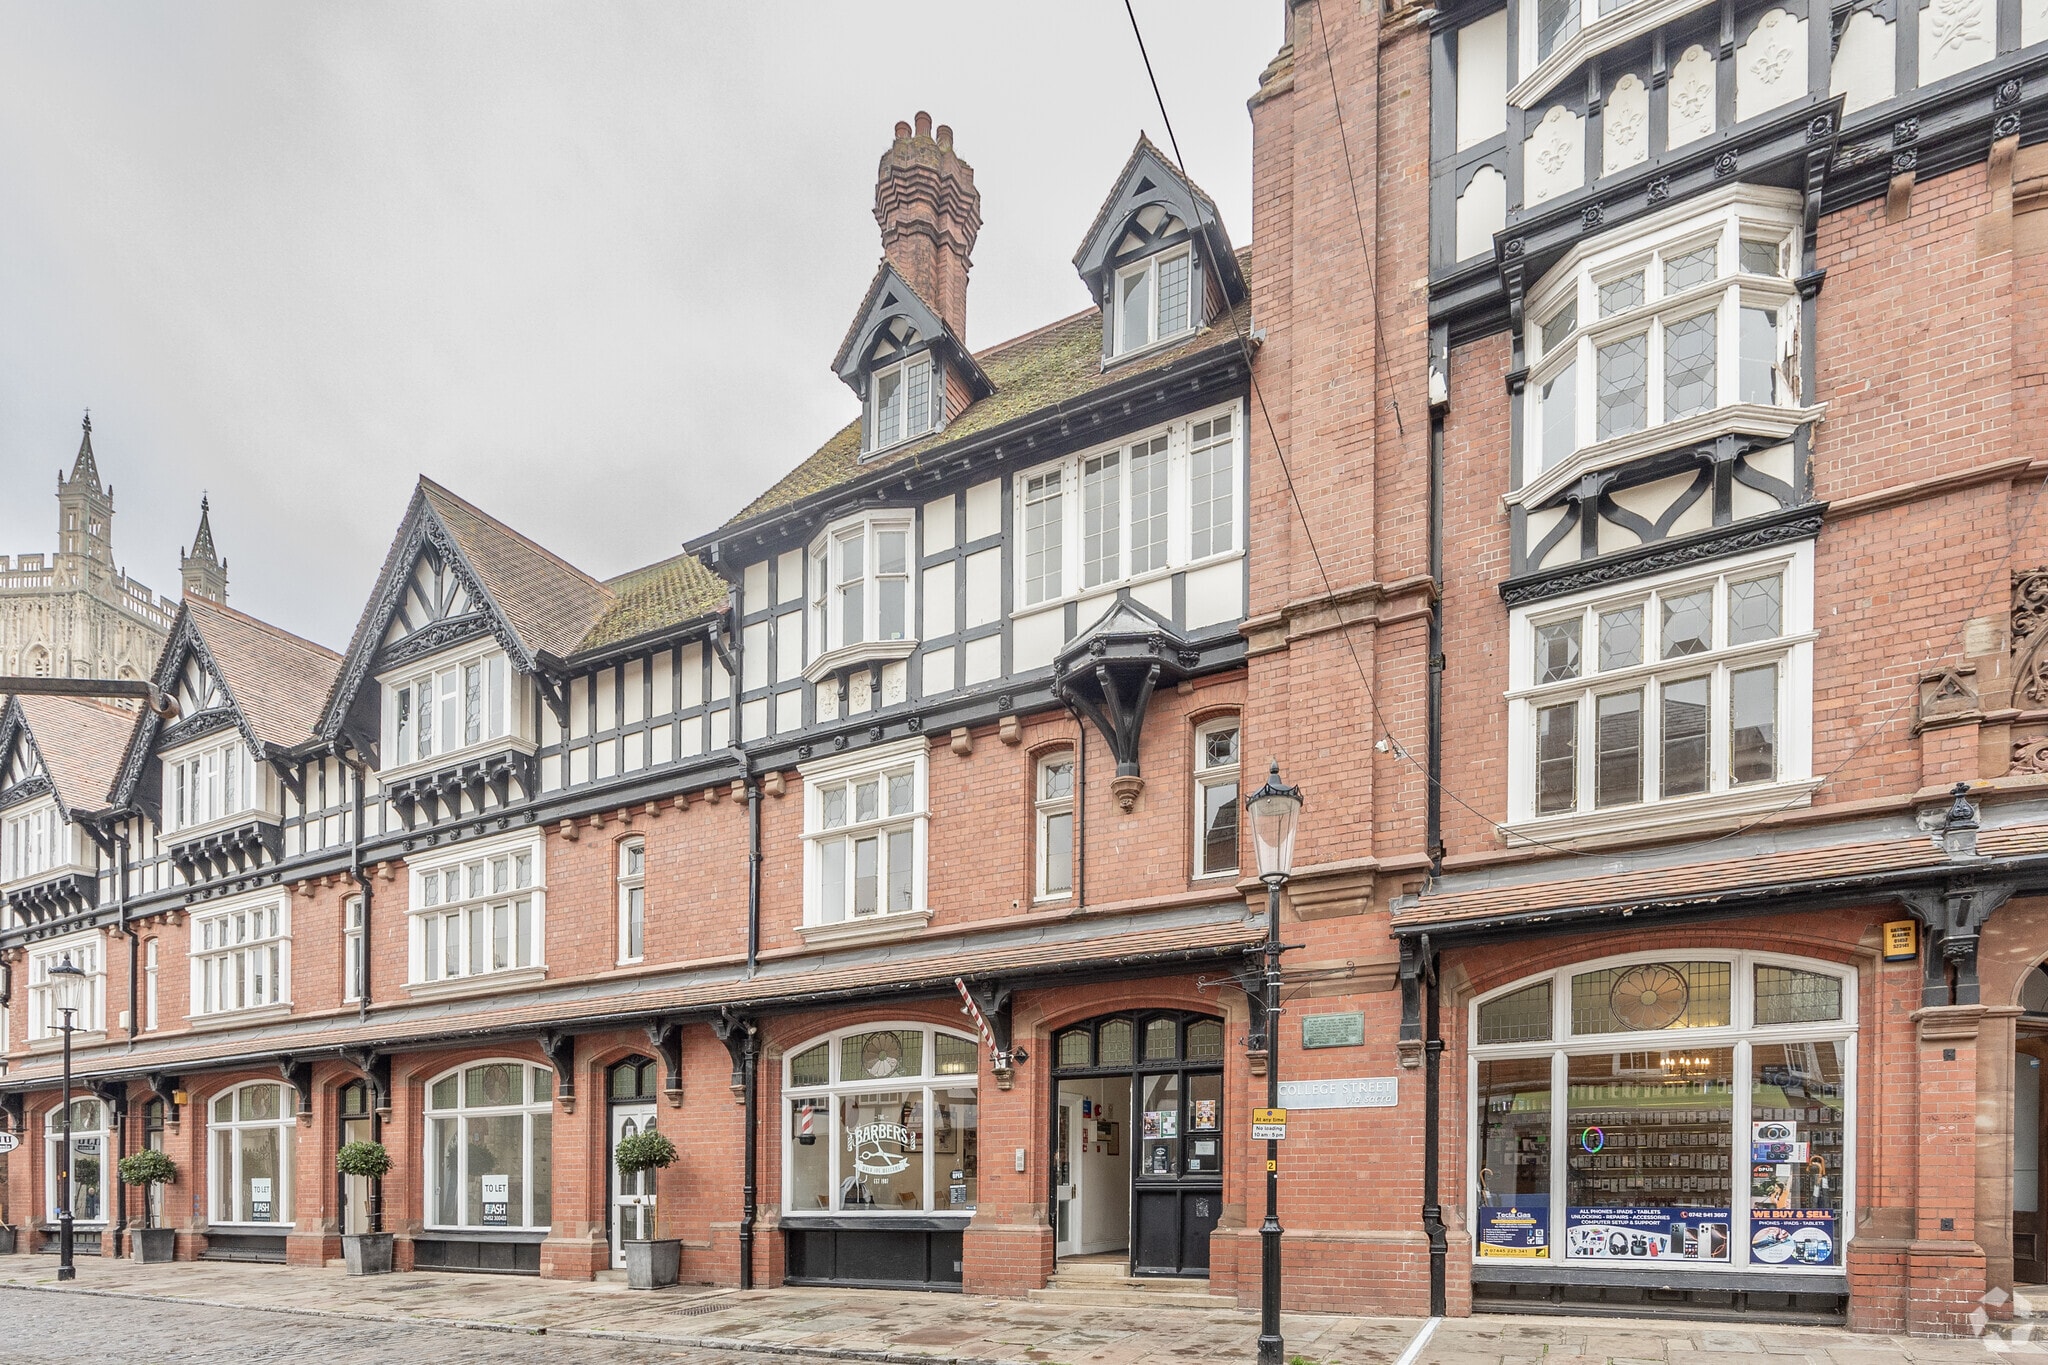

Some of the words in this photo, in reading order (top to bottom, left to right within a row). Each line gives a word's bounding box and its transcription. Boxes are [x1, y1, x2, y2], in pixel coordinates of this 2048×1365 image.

[1279, 1083, 1337, 1096] COLLEGE
[1342, 1081, 1393, 1094] STREET
[1346, 1096, 1360, 1104] via
[1364, 1095, 1392, 1103] sacra
[855, 1124, 908, 1144] BARBERS
[1268, 1162, 1274, 1170] 2
[485, 1184, 493, 1192] TO
[495, 1184, 506, 1192] LET
[1753, 1210, 1771, 1218] WE
[1772, 1210, 1794, 1218] BUY
[1796, 1210, 1804, 1218] &
[1806, 1210, 1831, 1218] SELL
